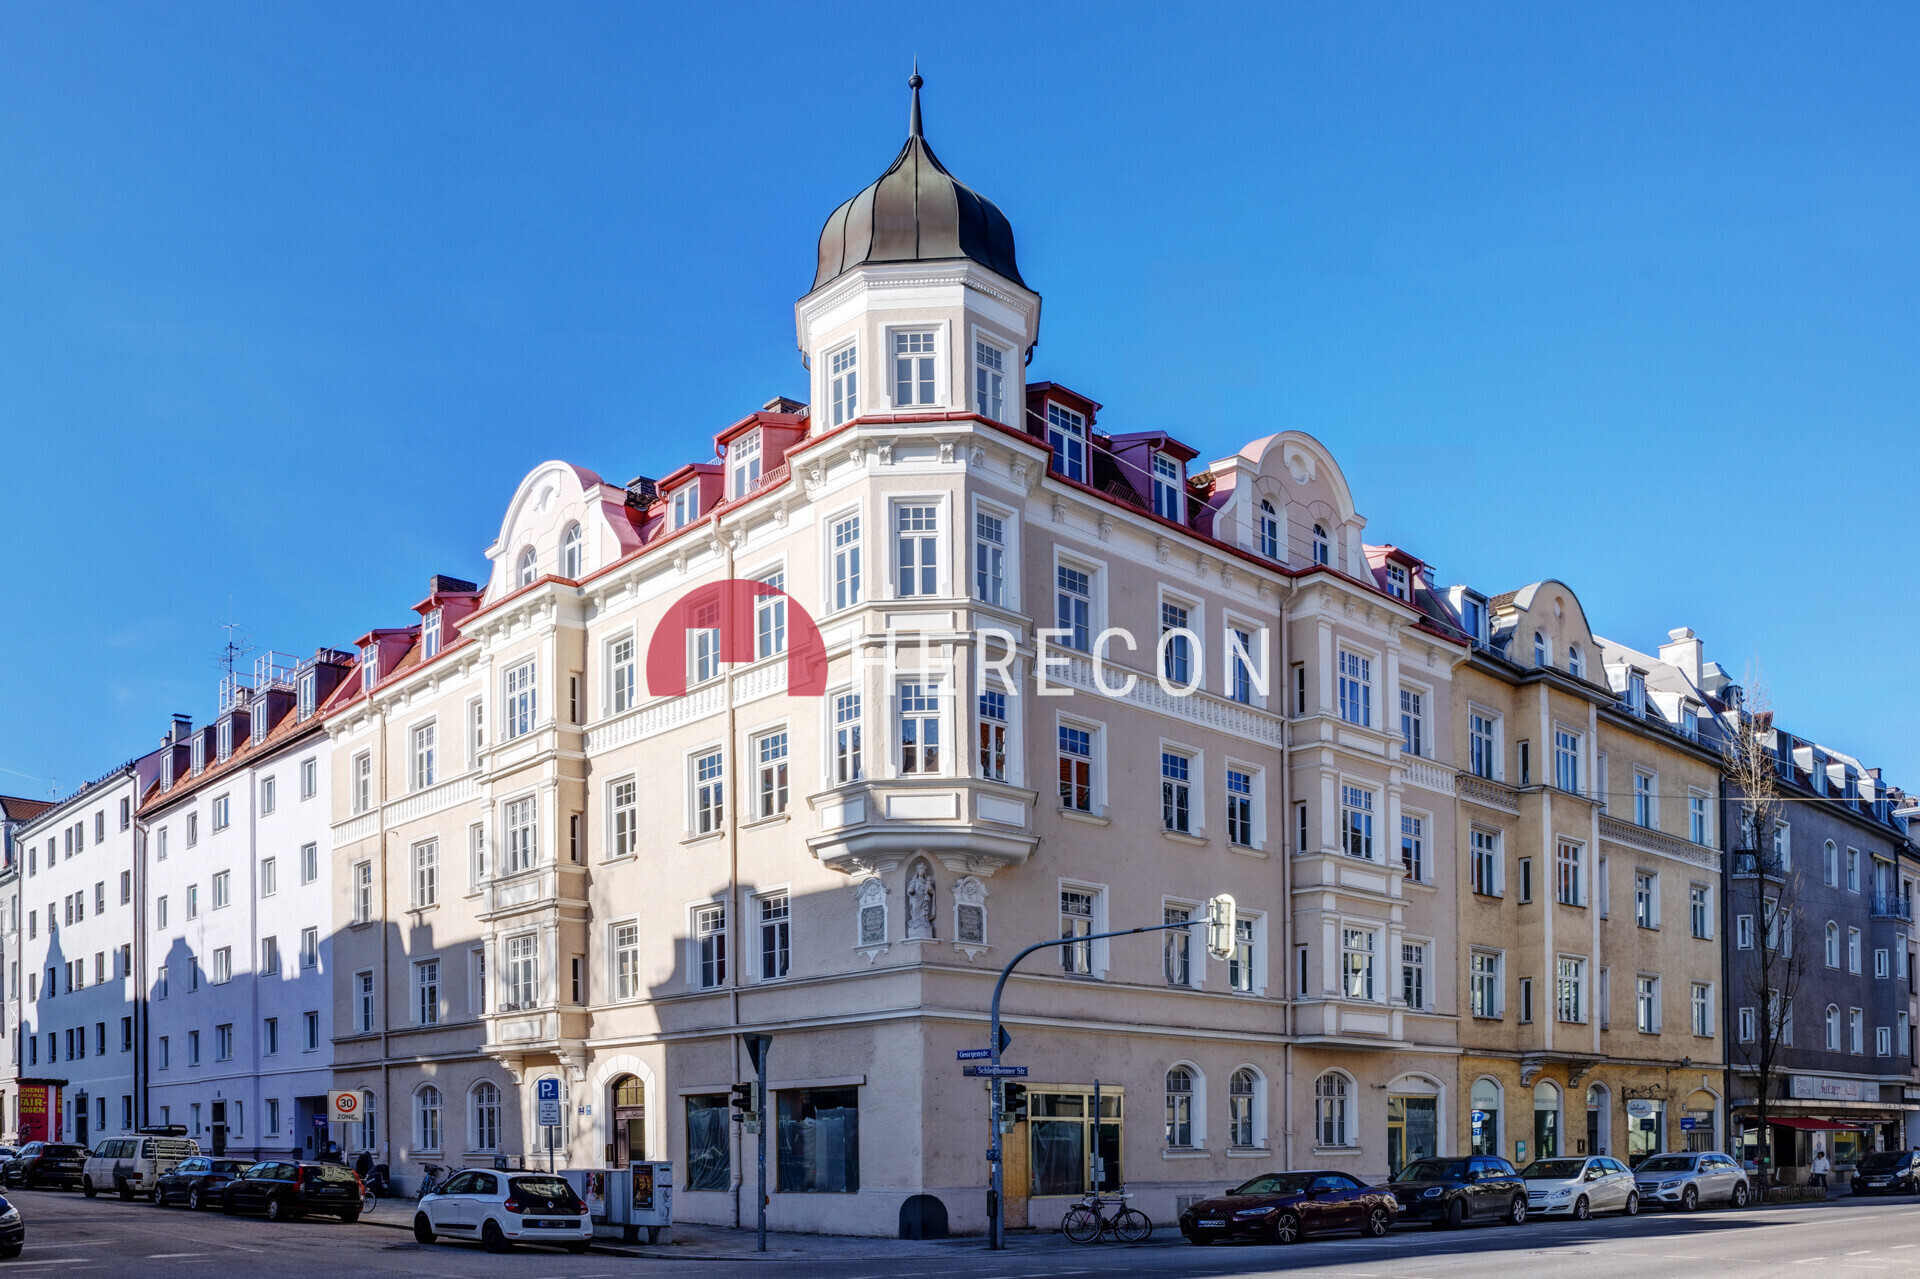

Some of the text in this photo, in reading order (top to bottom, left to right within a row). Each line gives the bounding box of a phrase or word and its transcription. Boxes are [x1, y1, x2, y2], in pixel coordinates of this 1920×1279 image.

[959, 1050, 989, 1058] Georgenstr.
[541, 1082, 553, 1098] P
[20, 1098, 47, 1106] FAIR-
[340, 1098, 352, 1108] 30
